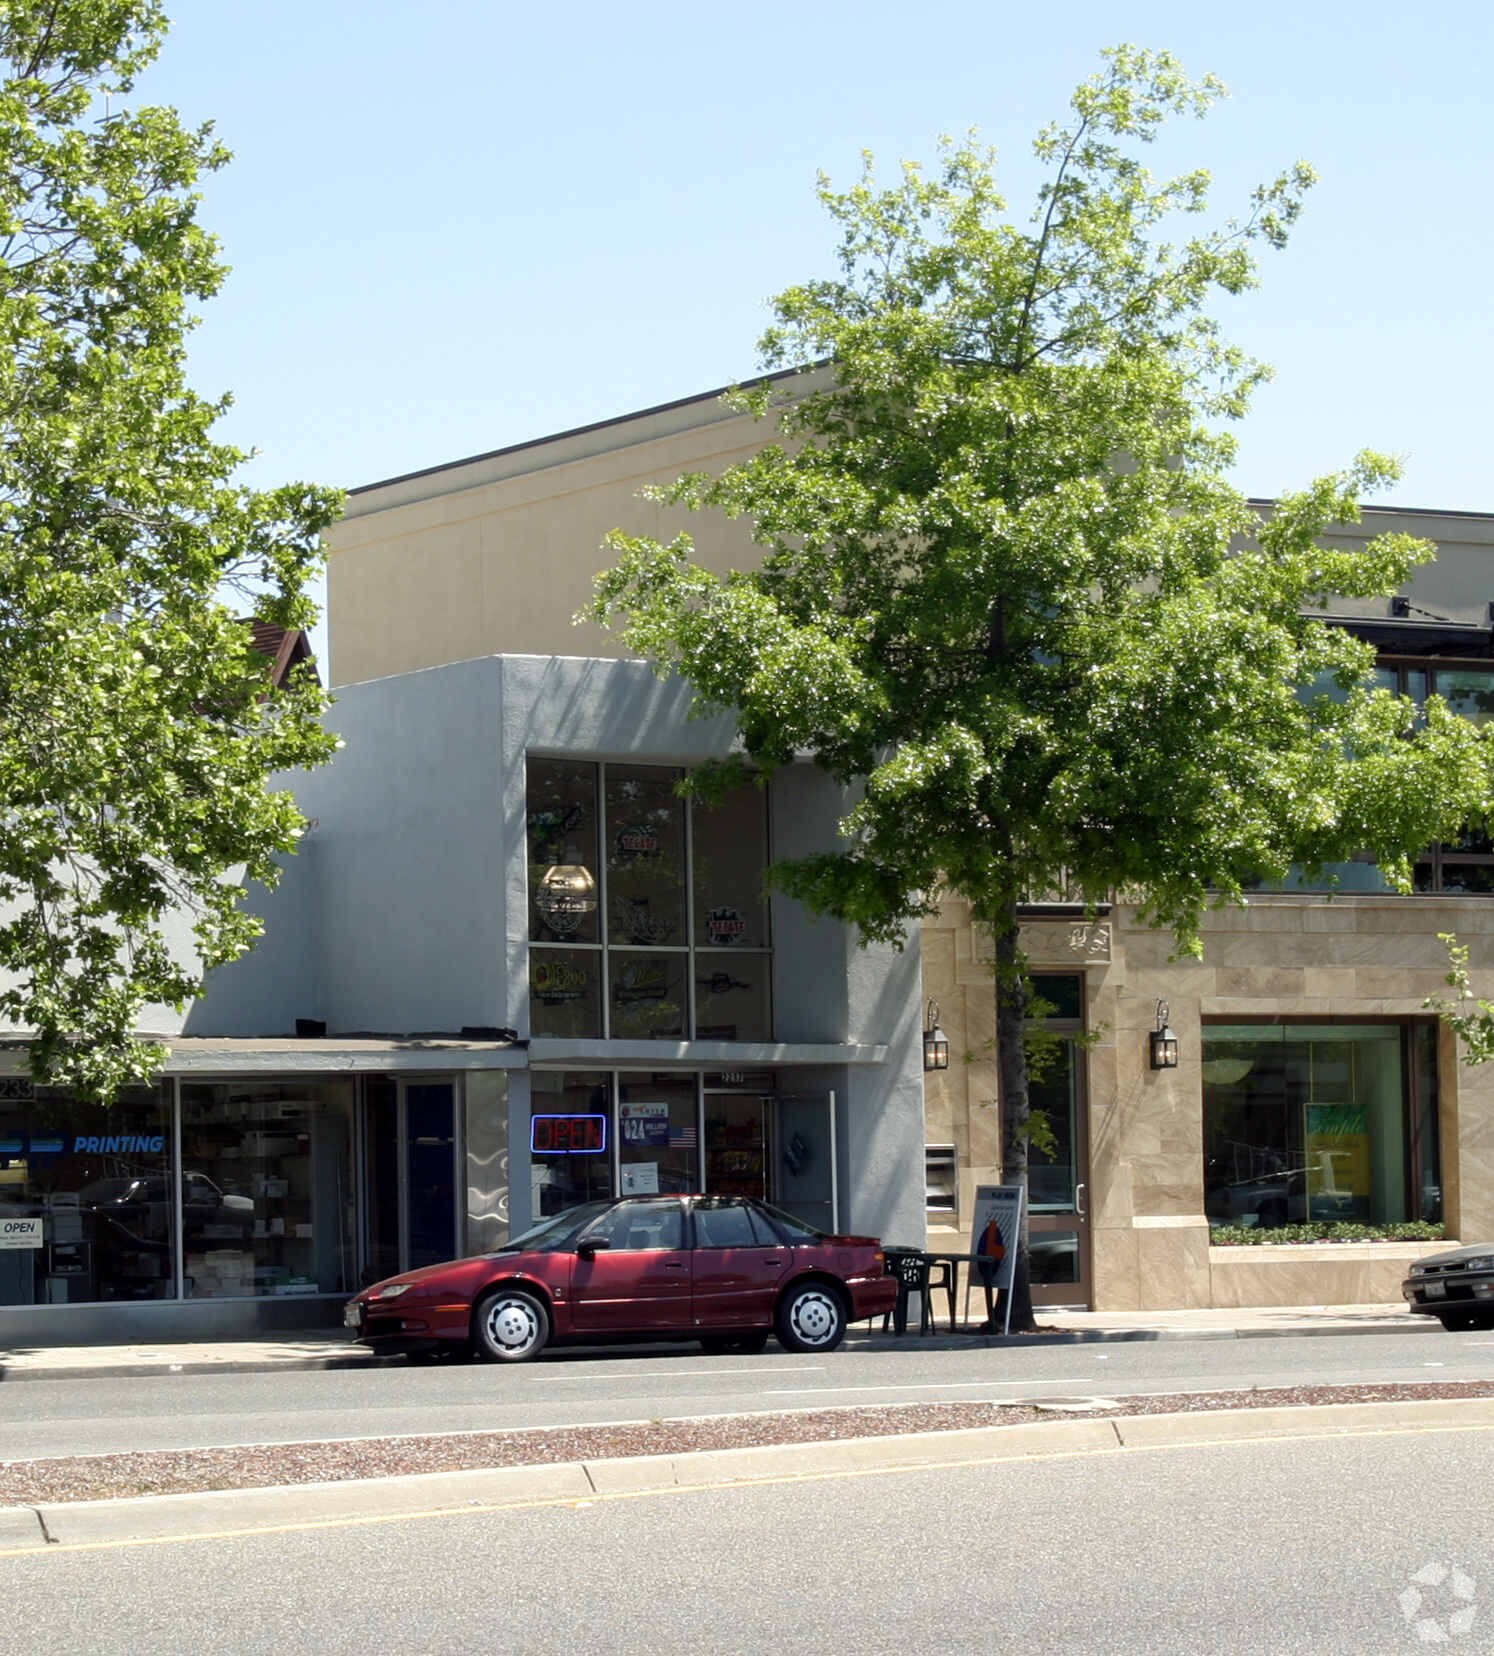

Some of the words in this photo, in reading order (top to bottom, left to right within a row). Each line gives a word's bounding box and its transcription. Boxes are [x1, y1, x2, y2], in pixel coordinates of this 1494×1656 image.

[534, 1118, 602, 1149] OPEN
[74, 1136, 165, 1153] PRINTING
[4, 1222, 36, 1234] OPEN
